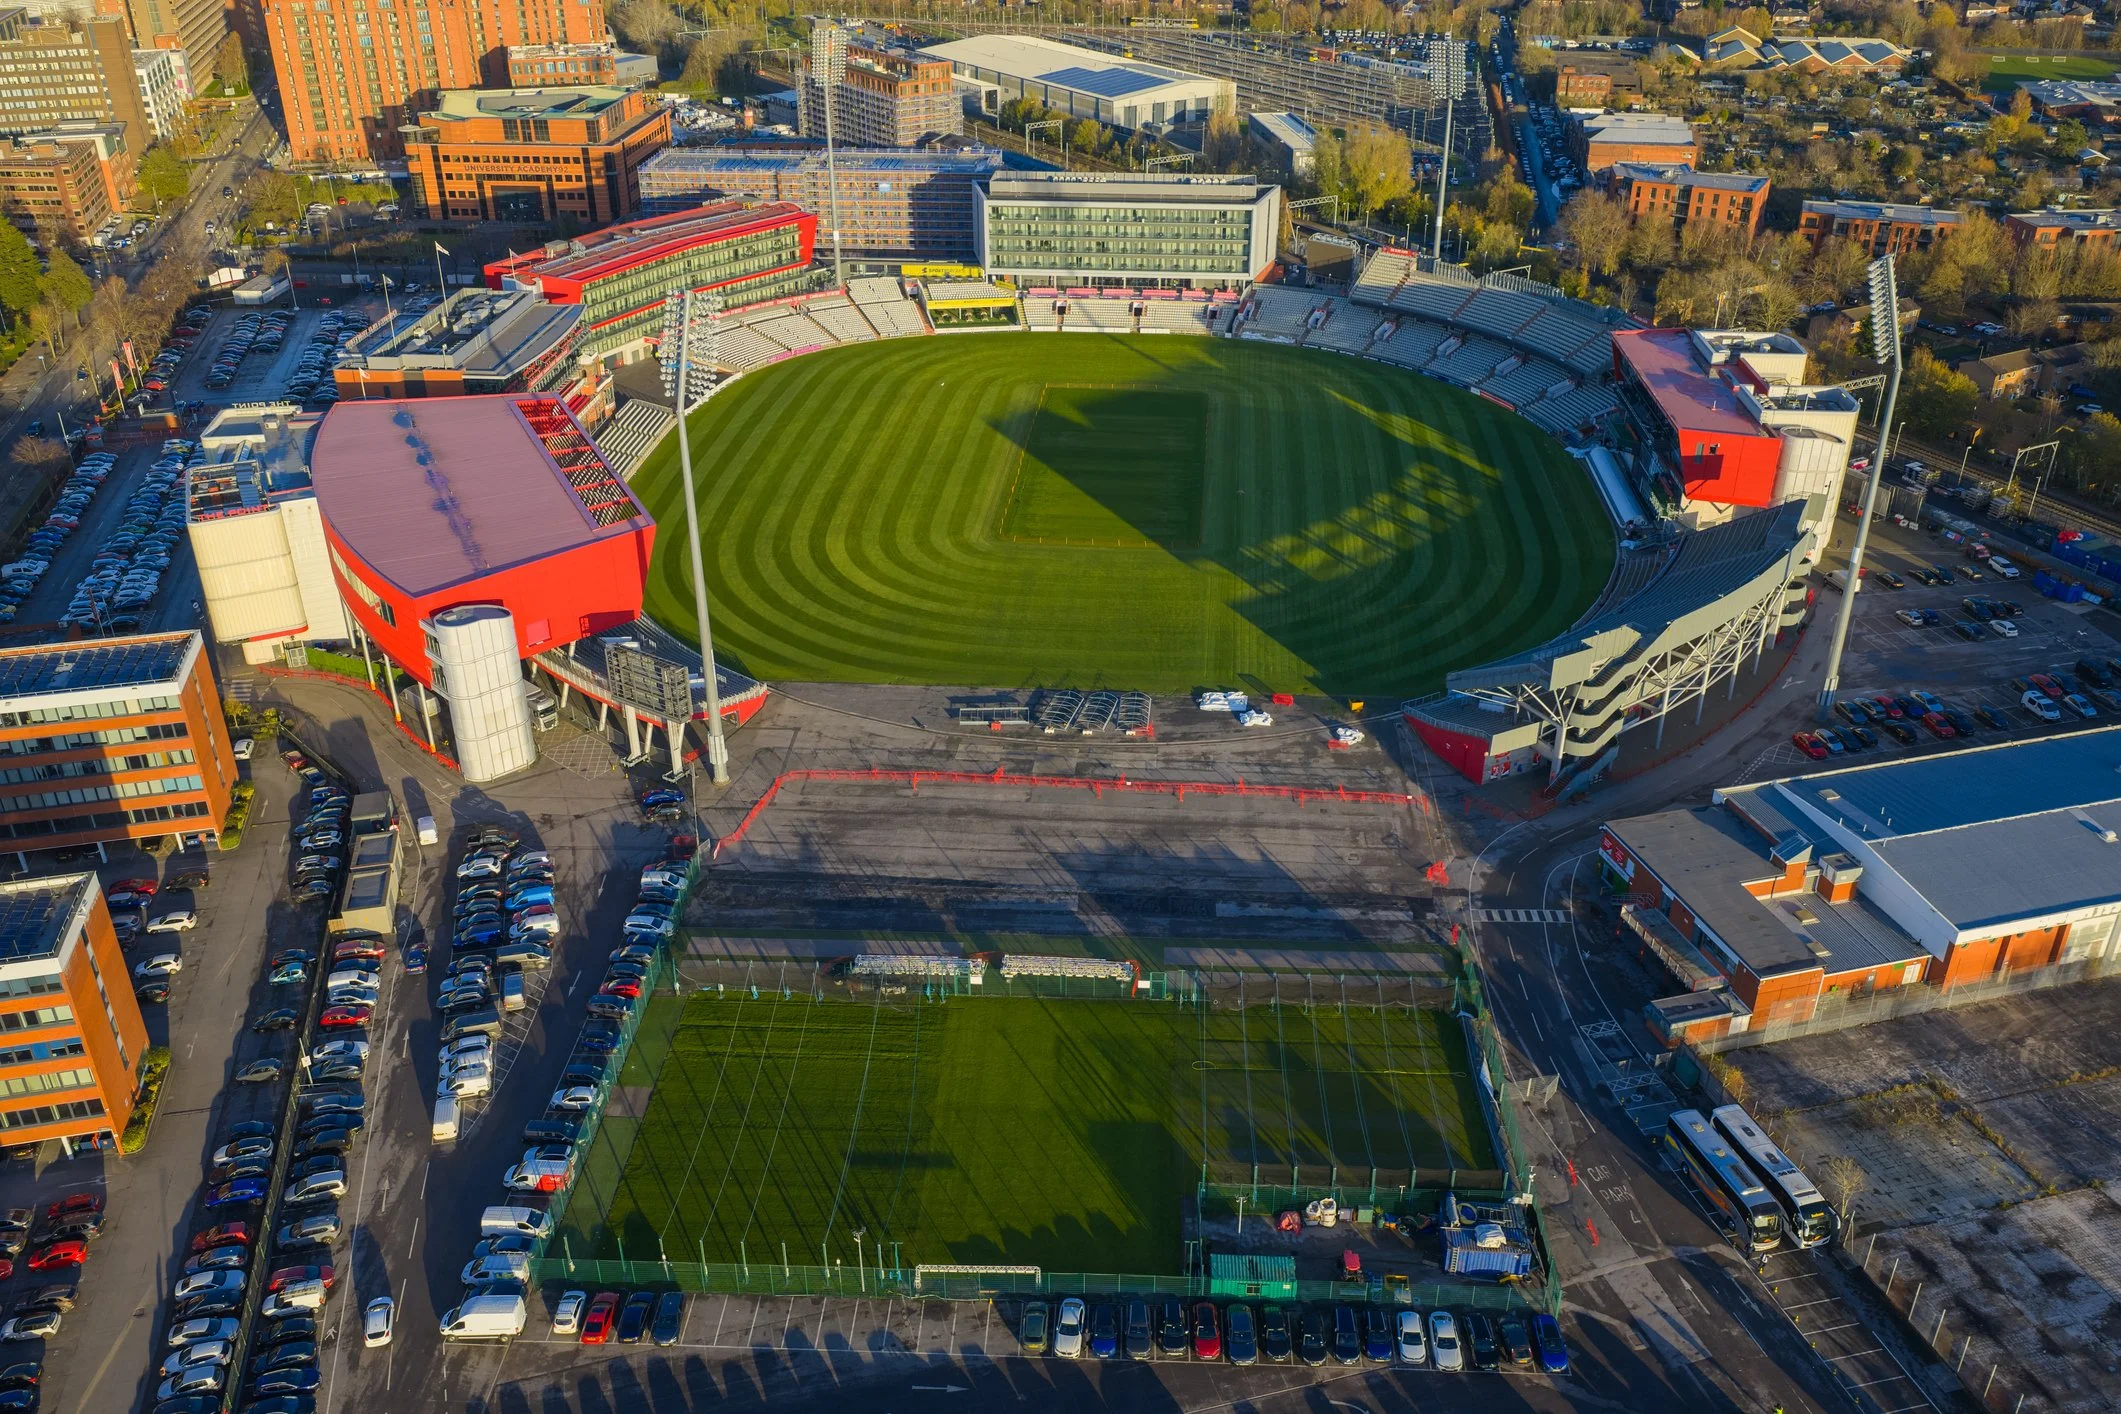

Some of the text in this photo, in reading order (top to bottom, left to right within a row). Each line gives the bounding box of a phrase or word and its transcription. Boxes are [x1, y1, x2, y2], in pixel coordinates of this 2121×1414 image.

[198, 504, 269, 522] THE POINT
[1587, 1165, 1613, 1182] CAR
[1599, 1184, 1635, 1206] PARK
